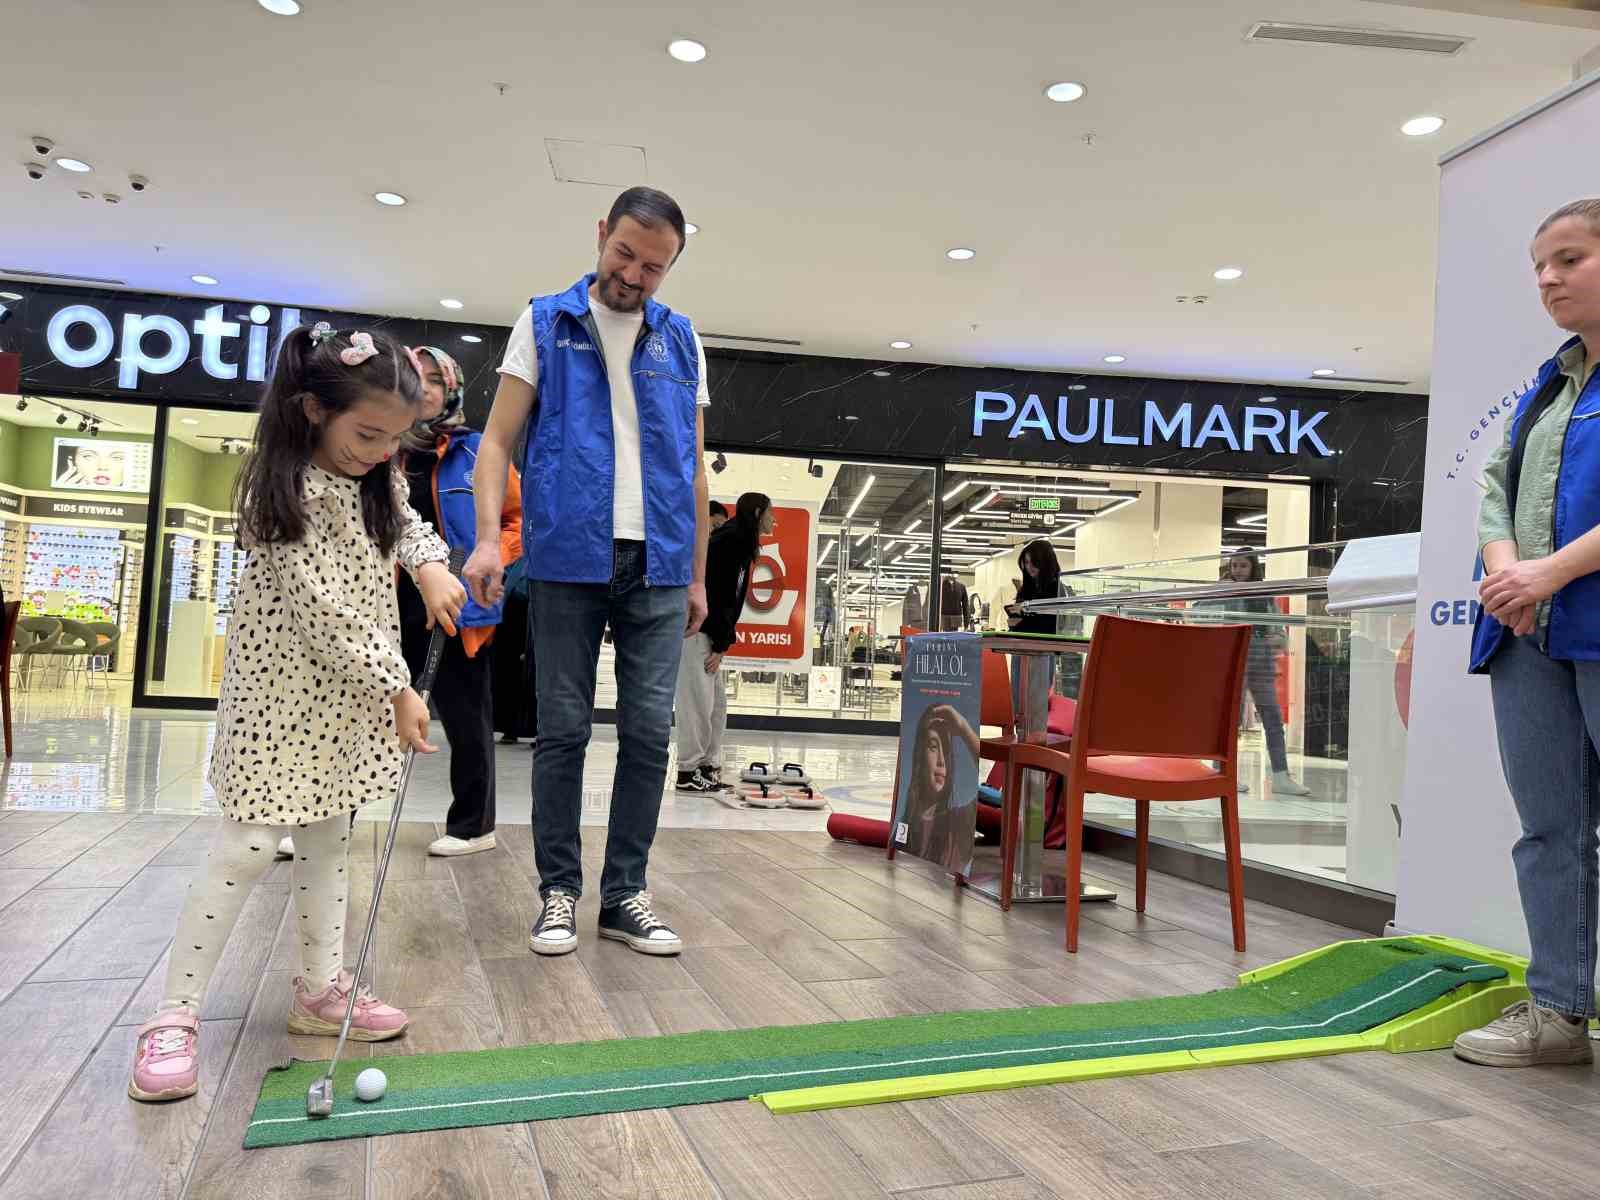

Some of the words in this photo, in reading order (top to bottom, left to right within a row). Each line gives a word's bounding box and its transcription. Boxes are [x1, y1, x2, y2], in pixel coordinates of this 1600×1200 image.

[53, 503, 76, 513] KIDS
[78, 505, 124, 516] EYEWEAR
[749, 632, 791, 646] YARISI
